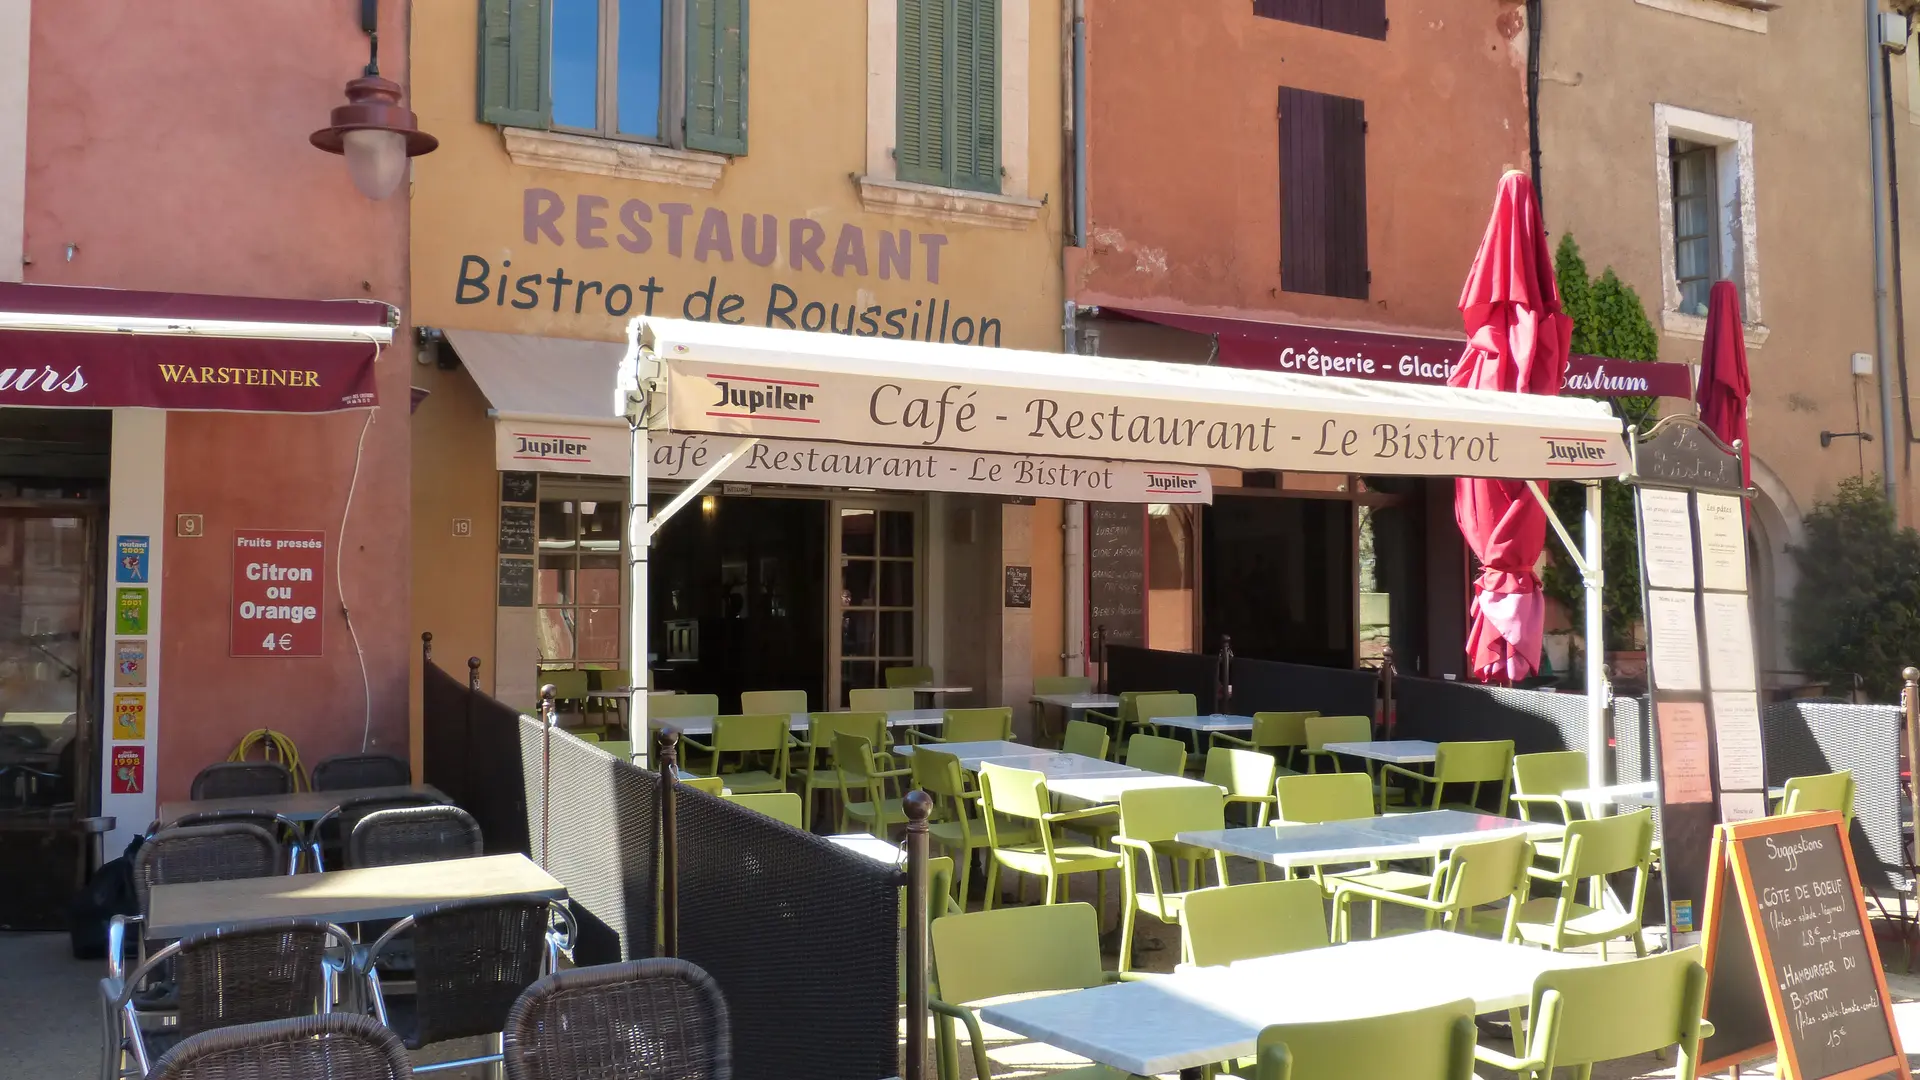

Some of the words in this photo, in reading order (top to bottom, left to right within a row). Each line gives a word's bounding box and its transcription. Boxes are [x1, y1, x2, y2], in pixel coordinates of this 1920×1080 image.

[523, 188, 949, 285] RESTAURANT
[454, 255, 664, 317] Bistrot
[682, 276, 745, 325] de
[766, 283, 1002, 348] Roussillon
[1280, 347, 1375, 377] Crêperie
[158, 364, 321, 388] WARSTEINER
[713, 381, 815, 414] Jupiler
[869, 383, 979, 445] Café
[1025, 398, 1277, 453] Restaurant
[1313, 419, 1358, 457] Le
[1372, 422, 1500, 463] Bistrot
[516, 437, 589, 459] Jupiler
[1546, 440, 1606, 463] Jupiler
[745, 443, 938, 480] Restaurant
[967, 456, 1002, 483] Le
[1013, 457, 1114, 491] Bistrot
[1146, 474, 1198, 491] Jupiler
[185, 519, 195, 533] 9
[455, 522, 468, 533] 19
[237, 538, 272, 548] Fruits
[276, 538, 322, 550] pressés
[246, 562, 313, 582] Citron
[266, 586, 292, 600] ou
[239, 601, 317, 624] Orange
[114, 758, 140, 766] 1998
[1766, 835, 1823, 872] Suggestions
[1795, 884, 1810, 900] DE
[1813, 879, 1842, 897] BOEUF
[1843, 956, 1856, 970] DU
